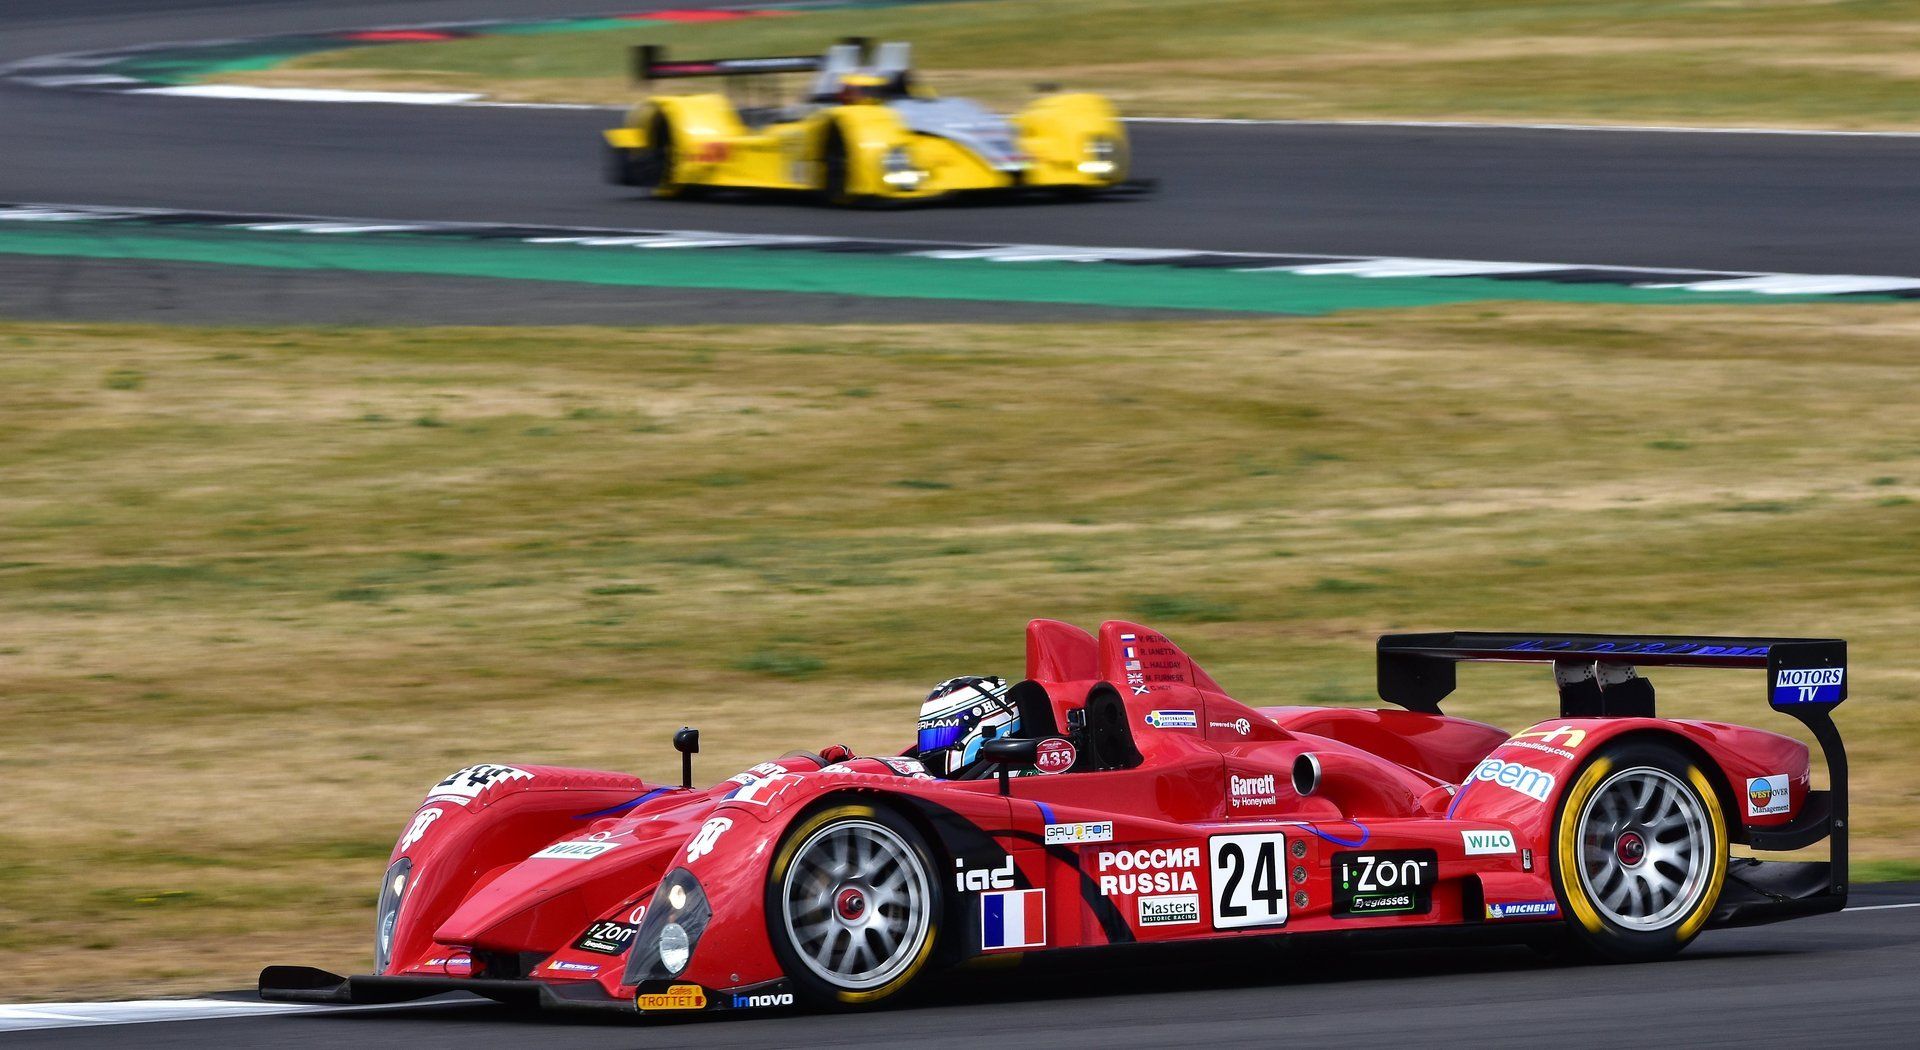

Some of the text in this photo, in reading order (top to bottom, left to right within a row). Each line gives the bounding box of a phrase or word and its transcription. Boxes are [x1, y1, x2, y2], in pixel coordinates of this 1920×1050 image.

[1779, 669, 1841, 686] MOTORS
[1798, 686, 1819, 702] TV
[1039, 750, 1072, 767] 433
[1230, 774, 1275, 796] Garrett
[1232, 796, 1276, 808] by Honeywell
[1752, 804, 1789, 814] Management
[1467, 835, 1510, 848] WILO
[546, 844, 605, 855] WILO
[1099, 847, 1200, 872] РОССИЯ
[956, 855, 1015, 892] iad
[1218, 842, 1283, 917] 24
[1100, 871, 1198, 896] RUSSIA
[1142, 902, 1196, 915] Masters
[1353, 896, 1410, 908] Eyeglasses
[1505, 903, 1556, 914] MICHELIN
[642, 996, 691, 1007] TROTTET
[733, 994, 793, 1008] innovo
